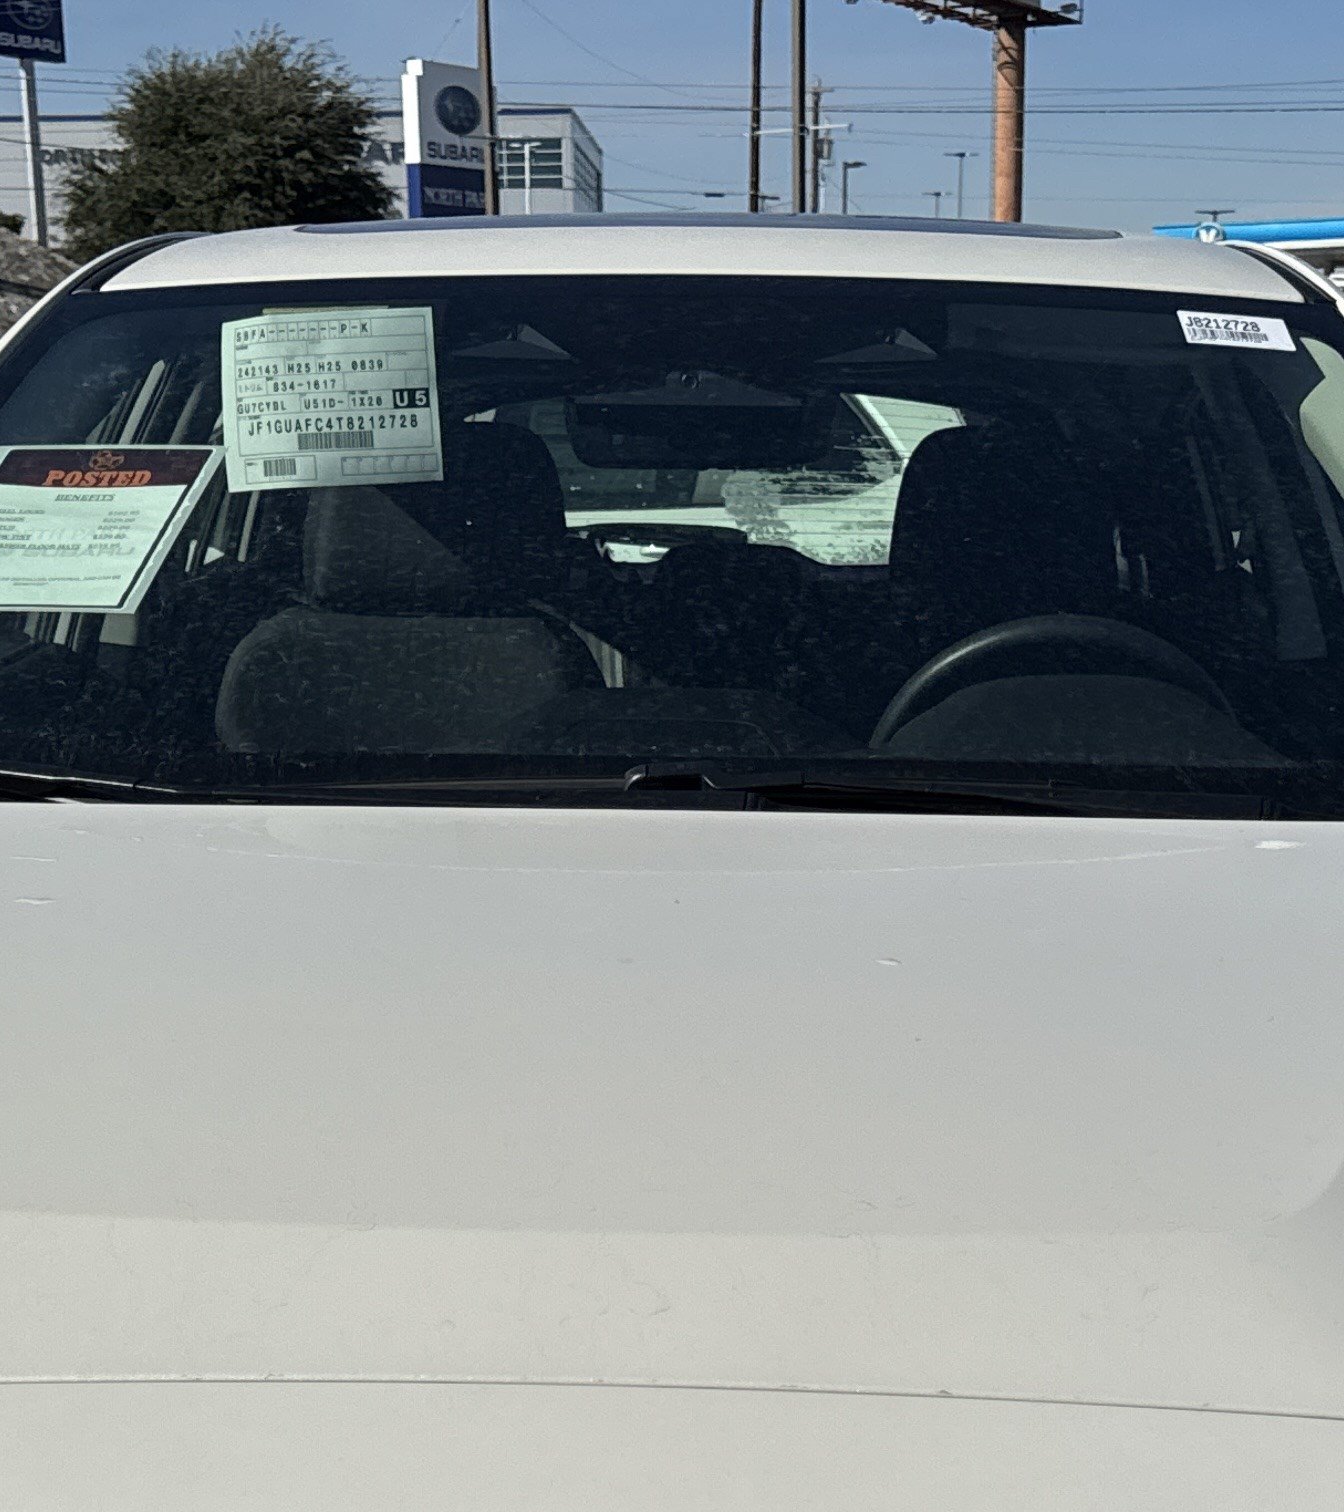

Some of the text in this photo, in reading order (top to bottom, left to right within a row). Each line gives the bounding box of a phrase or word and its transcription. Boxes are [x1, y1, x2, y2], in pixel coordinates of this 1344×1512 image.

[248, 412, 419, 437] JF1GUAFC4T8212728
[42, 469, 152, 487] POSTED
[55, 493, 116, 502] BENEFITS
